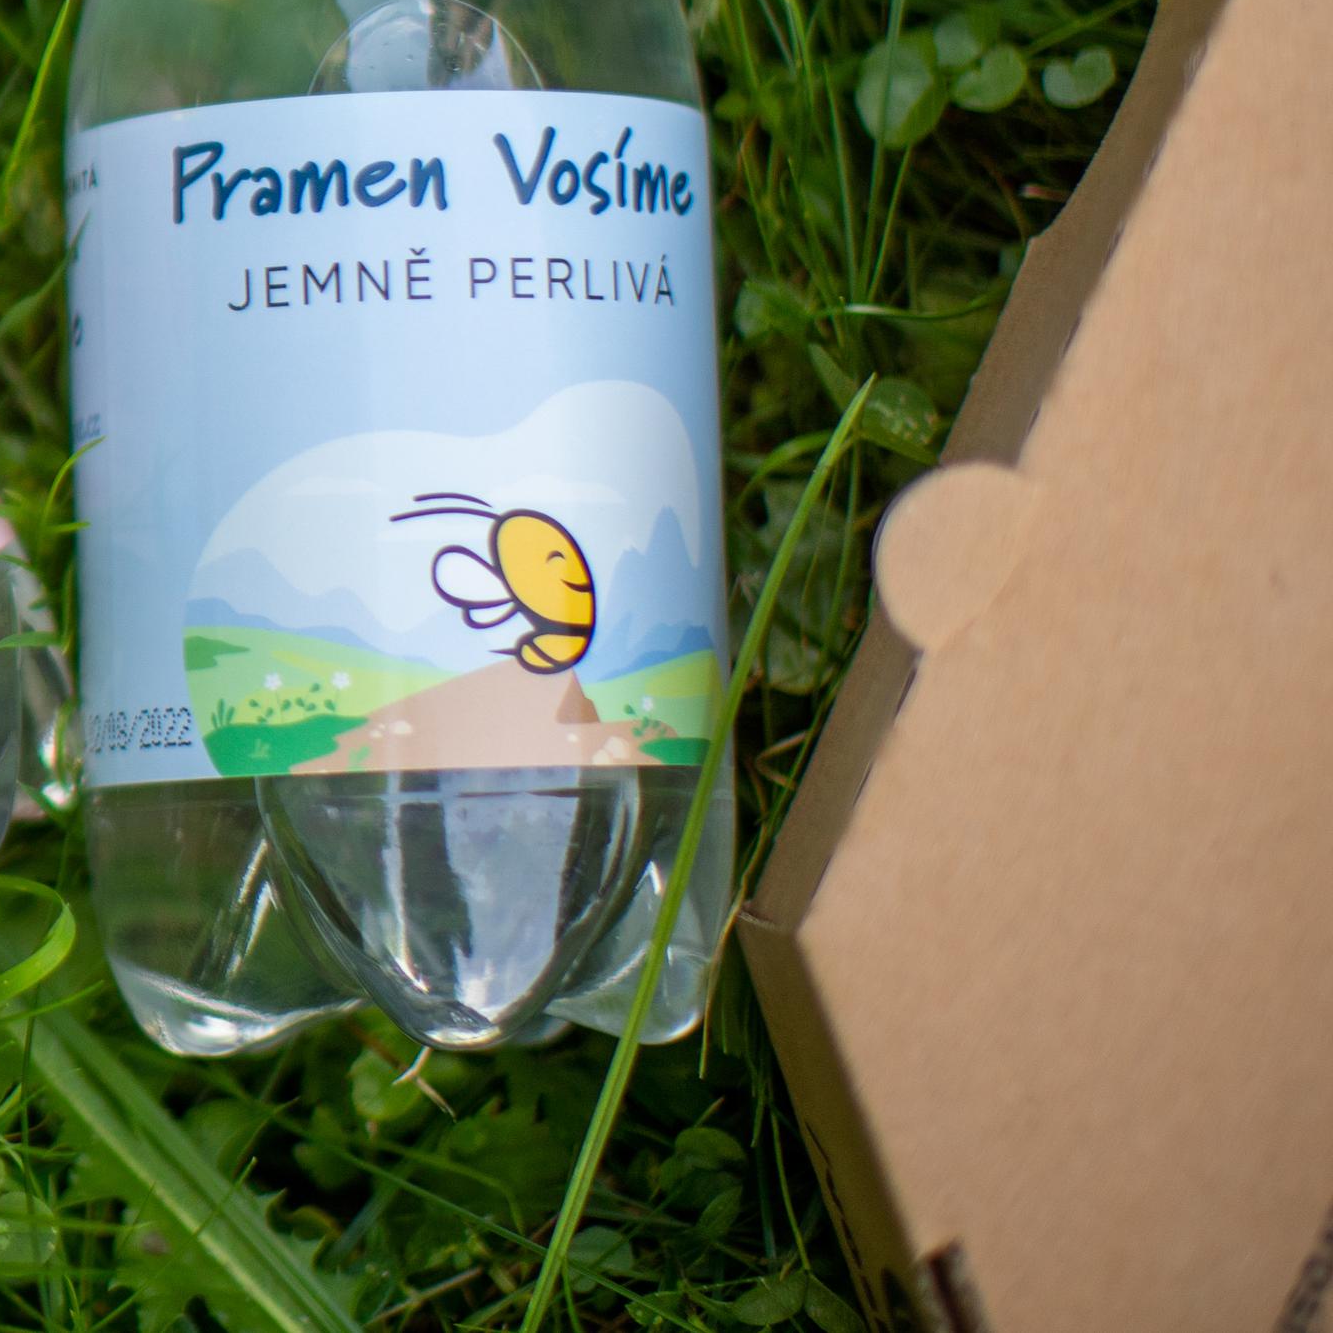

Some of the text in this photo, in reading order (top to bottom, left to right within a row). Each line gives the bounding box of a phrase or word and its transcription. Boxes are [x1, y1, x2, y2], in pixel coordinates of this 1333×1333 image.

[171, 126, 693, 224] Pramen Vosíme
[228, 247, 676, 312] JEMNĚ PERLIVÁ
